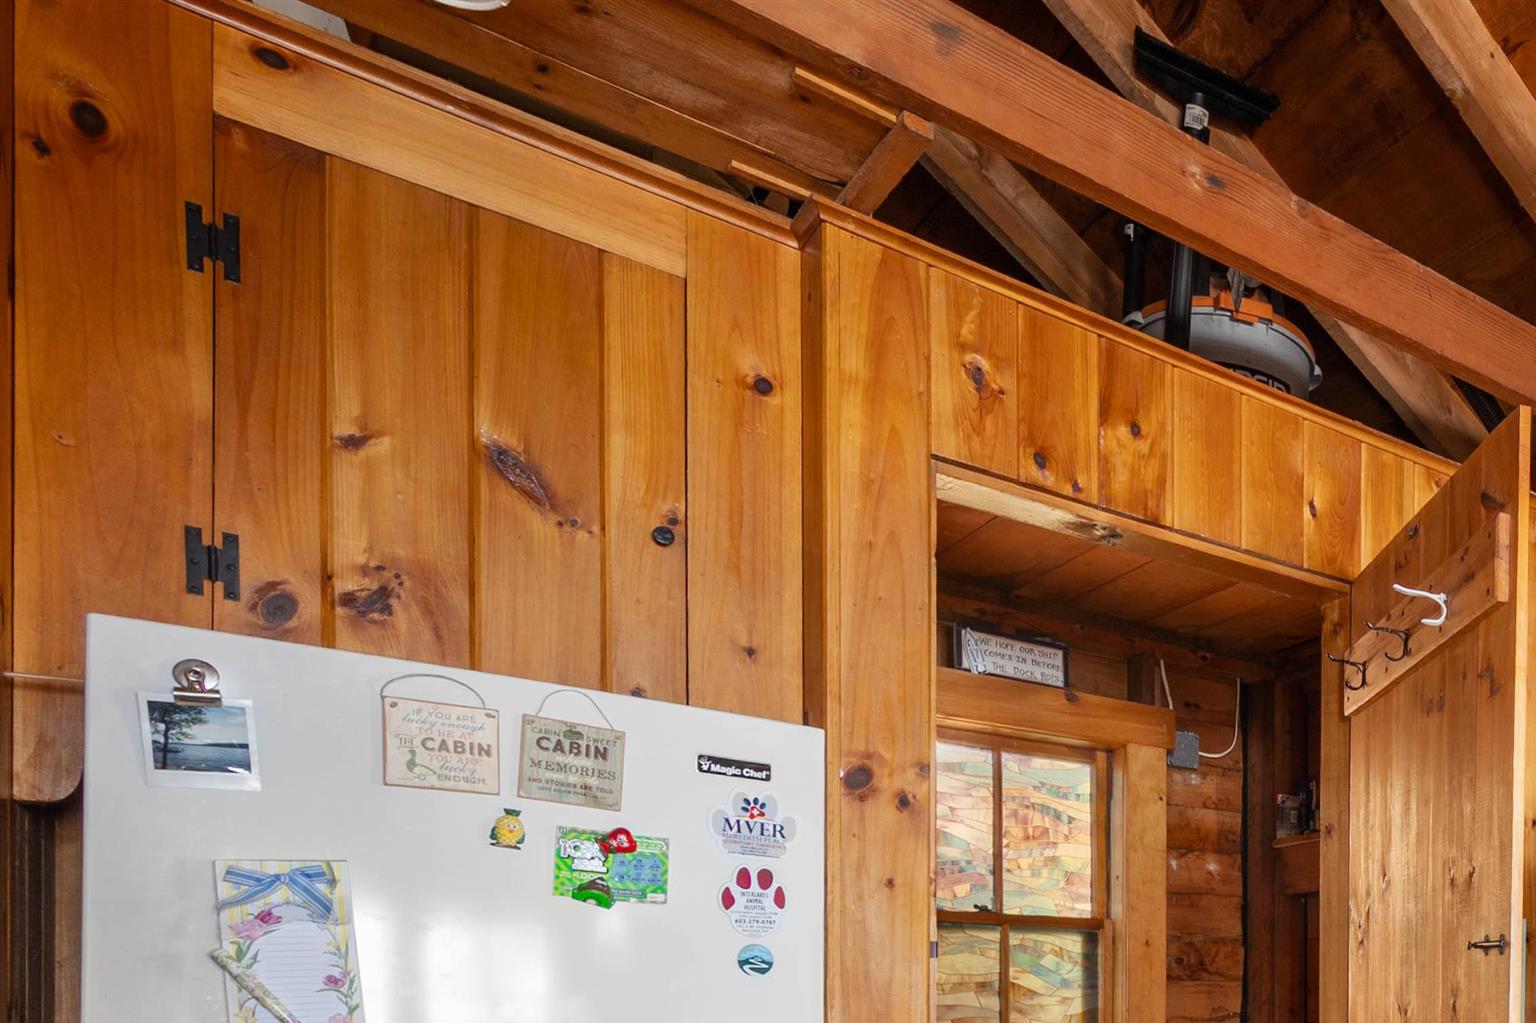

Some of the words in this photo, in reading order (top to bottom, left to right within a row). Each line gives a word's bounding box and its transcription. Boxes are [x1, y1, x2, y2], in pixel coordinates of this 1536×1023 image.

[983, 648, 1013, 661] COMES
[1015, 655, 1027, 665] IN
[1019, 646, 1036, 656] OUR
[992, 661, 1007, 672] THE
[1013, 666, 1037, 680] DOCK
[402, 713, 438, 728] lucky
[440, 721, 486, 733] enough
[428, 710, 452, 720] YOU
[456, 714, 476, 723] ARE
[438, 729, 455, 738] BE
[531, 726, 560, 737] CABIN
[585, 735, 617, 747] SWEET
[399, 737, 414, 746] THE
[421, 736, 492, 758] CABIN
[535, 735, 609, 761] CABIN
[427, 753, 452, 763] YOU
[457, 757, 482, 767] ARE
[439, 762, 477, 777] lucky
[529, 758, 617, 781] MEMORIES
[710, 763, 741, 776] Magic
[743, 768, 767, 779] Chef
[528, 777, 543, 785] AND
[544, 778, 577, 789] STORIES
[722, 817, 786, 839] MVER
